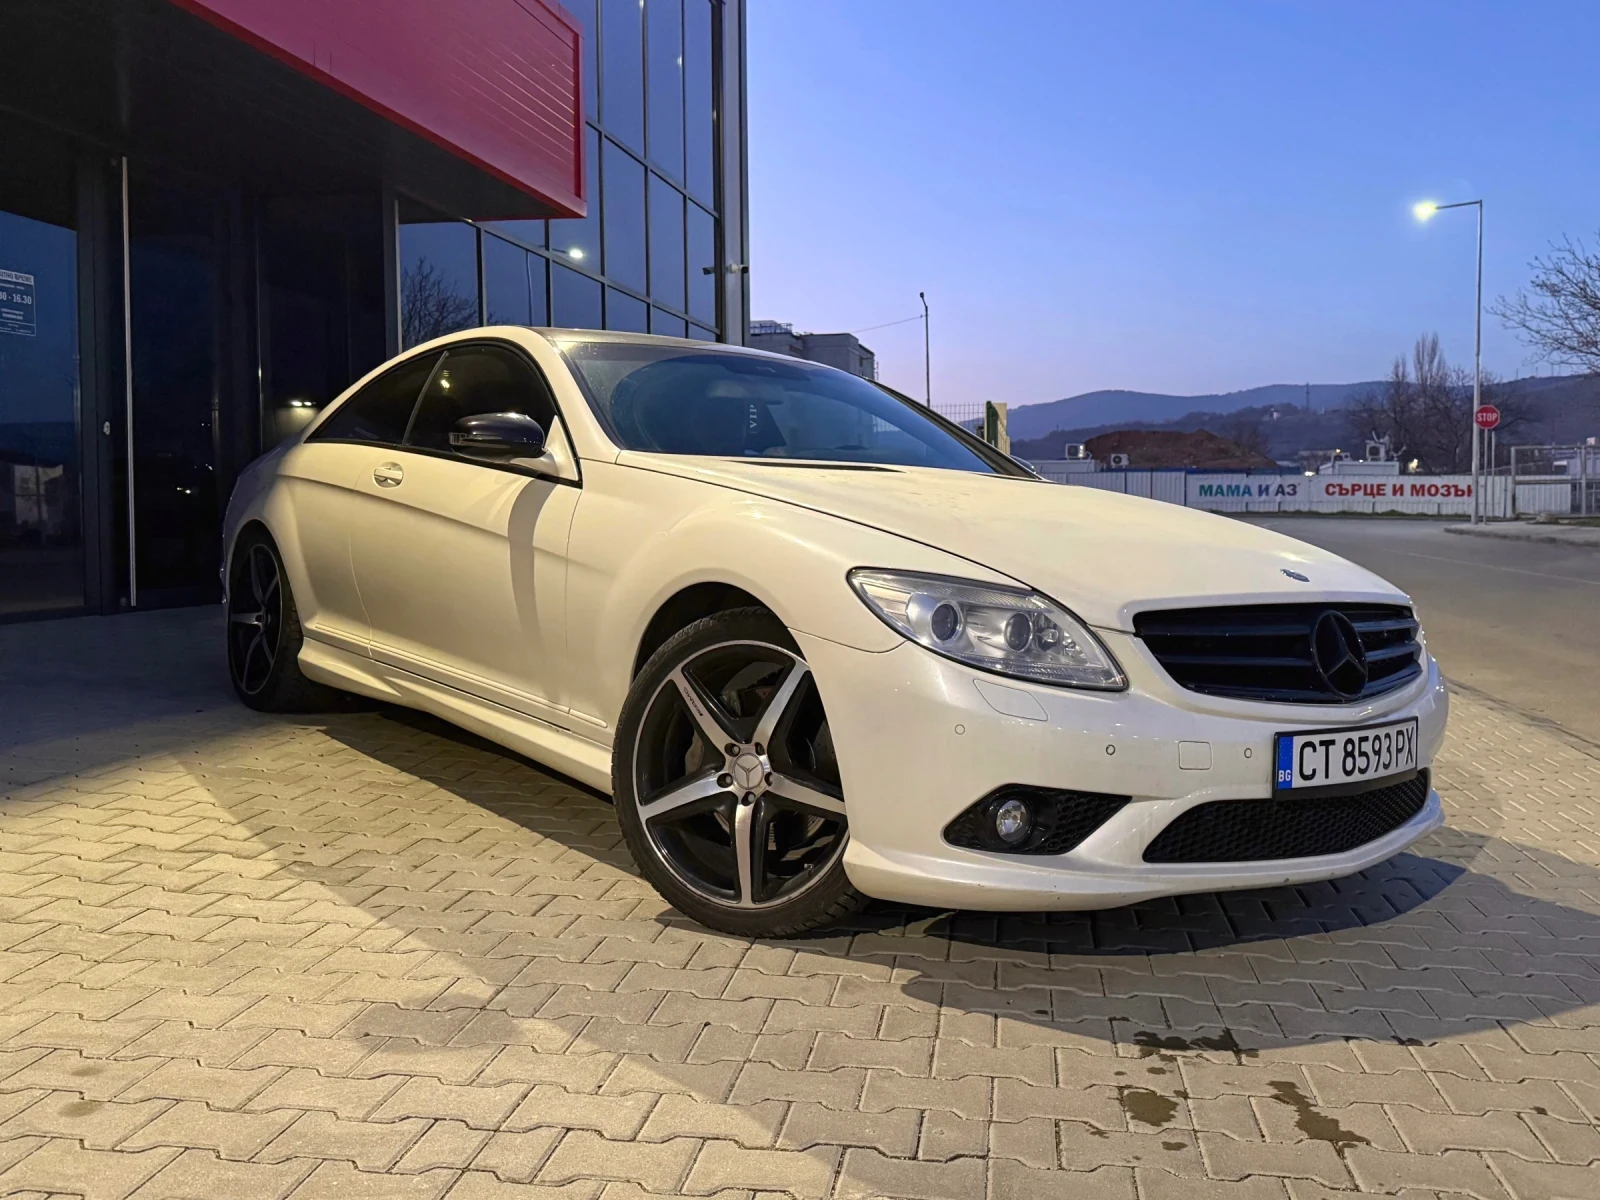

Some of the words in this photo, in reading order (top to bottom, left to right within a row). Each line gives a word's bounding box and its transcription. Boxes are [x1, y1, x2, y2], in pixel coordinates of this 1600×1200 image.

[13, 294, 32, 304] 16.30
[1477, 412, 1498, 422] STOP
[1199, 484, 1252, 497] МАМА
[1257, 484, 1270, 497] И
[1325, 483, 1387, 498] СЪРЦЕ
[1392, 484, 1405, 497] И
[1299, 738, 1336, 782] CT
[1341, 733, 1392, 777] 8593
[1395, 726, 1415, 768] PX
[1278, 770, 1292, 782] BG
